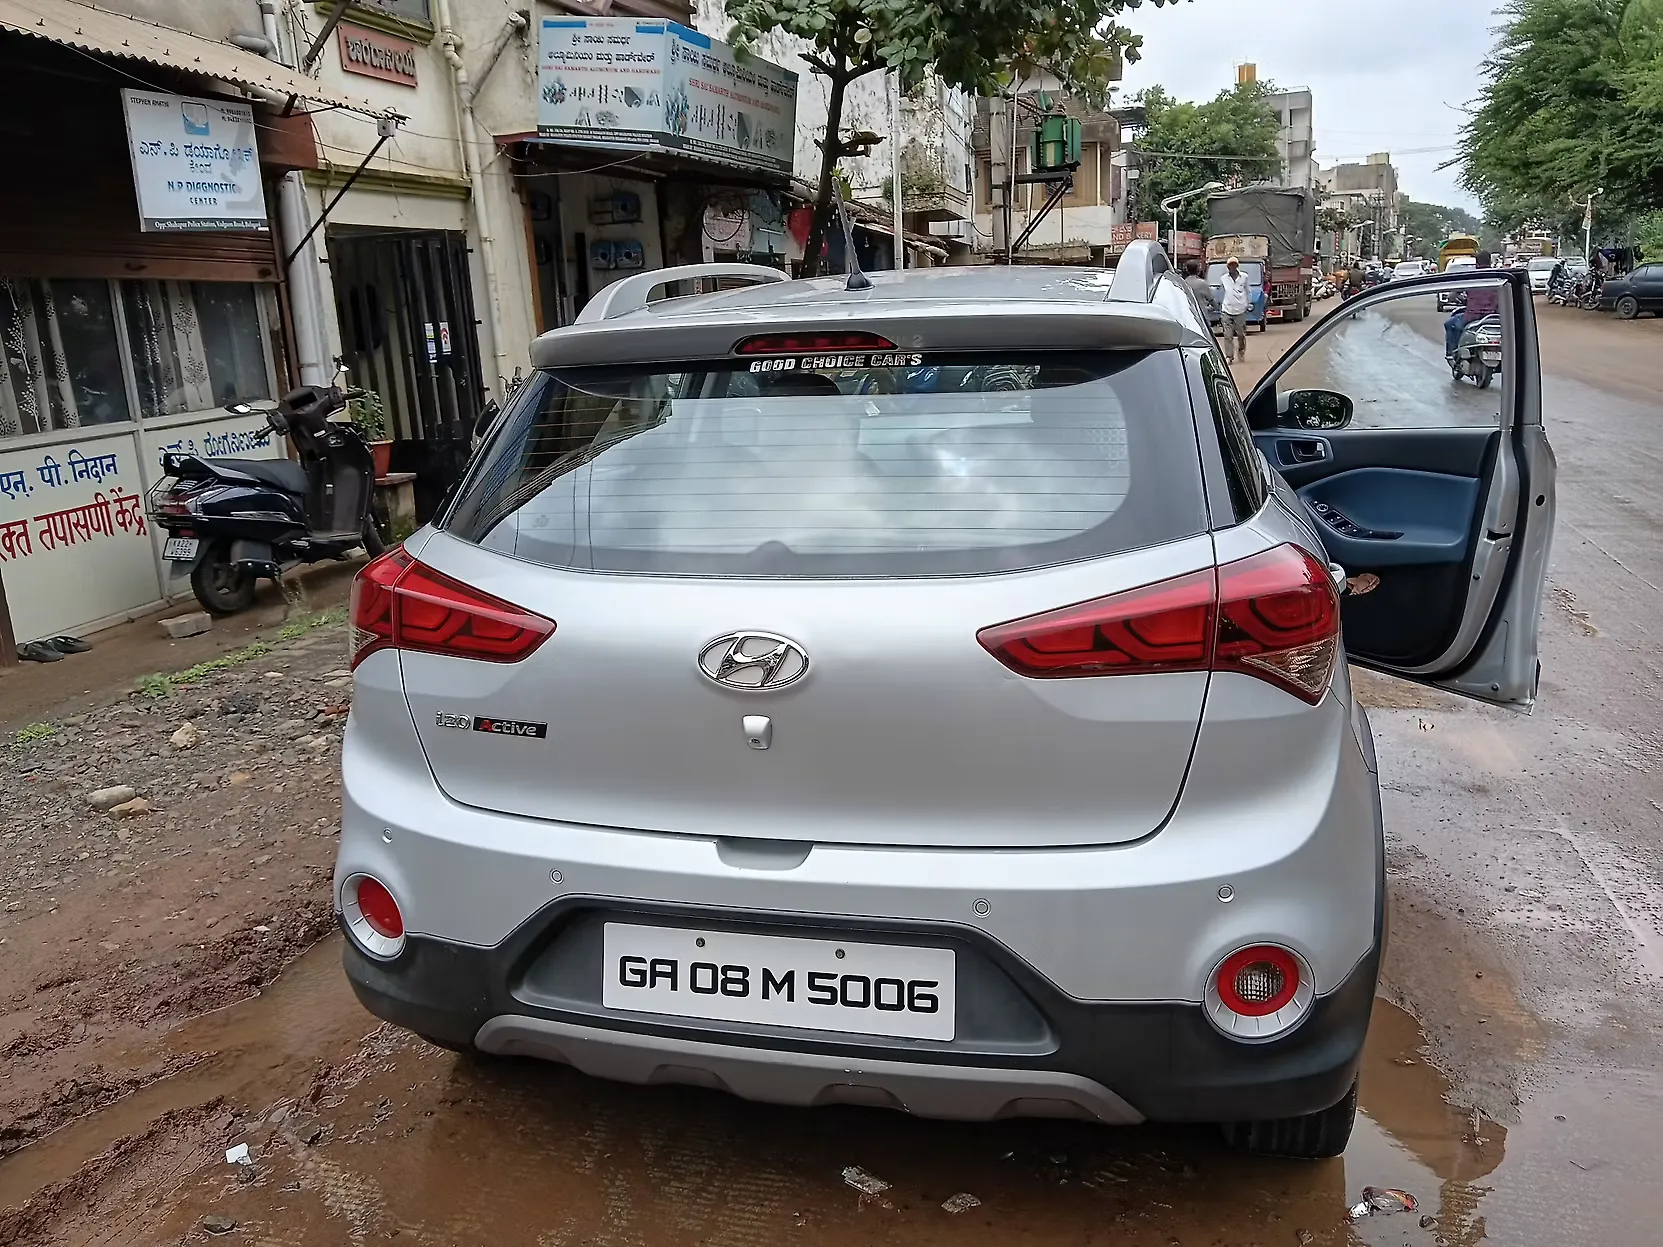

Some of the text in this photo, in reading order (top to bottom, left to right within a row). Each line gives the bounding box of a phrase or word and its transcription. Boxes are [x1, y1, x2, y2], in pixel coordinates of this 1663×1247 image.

[186, 181, 237, 194] DIAGNOSTIC
[189, 197, 218, 205] CENTER
[750, 353, 922, 373] GOOD CHOICE CAR'S
[67, 448, 118, 484] निदान
[0, 486, 147, 562] क्त तपासणी केंद्र
[436, 710, 537, 736] i20 Active
[619, 955, 940, 1014] GA 08 M 5006
